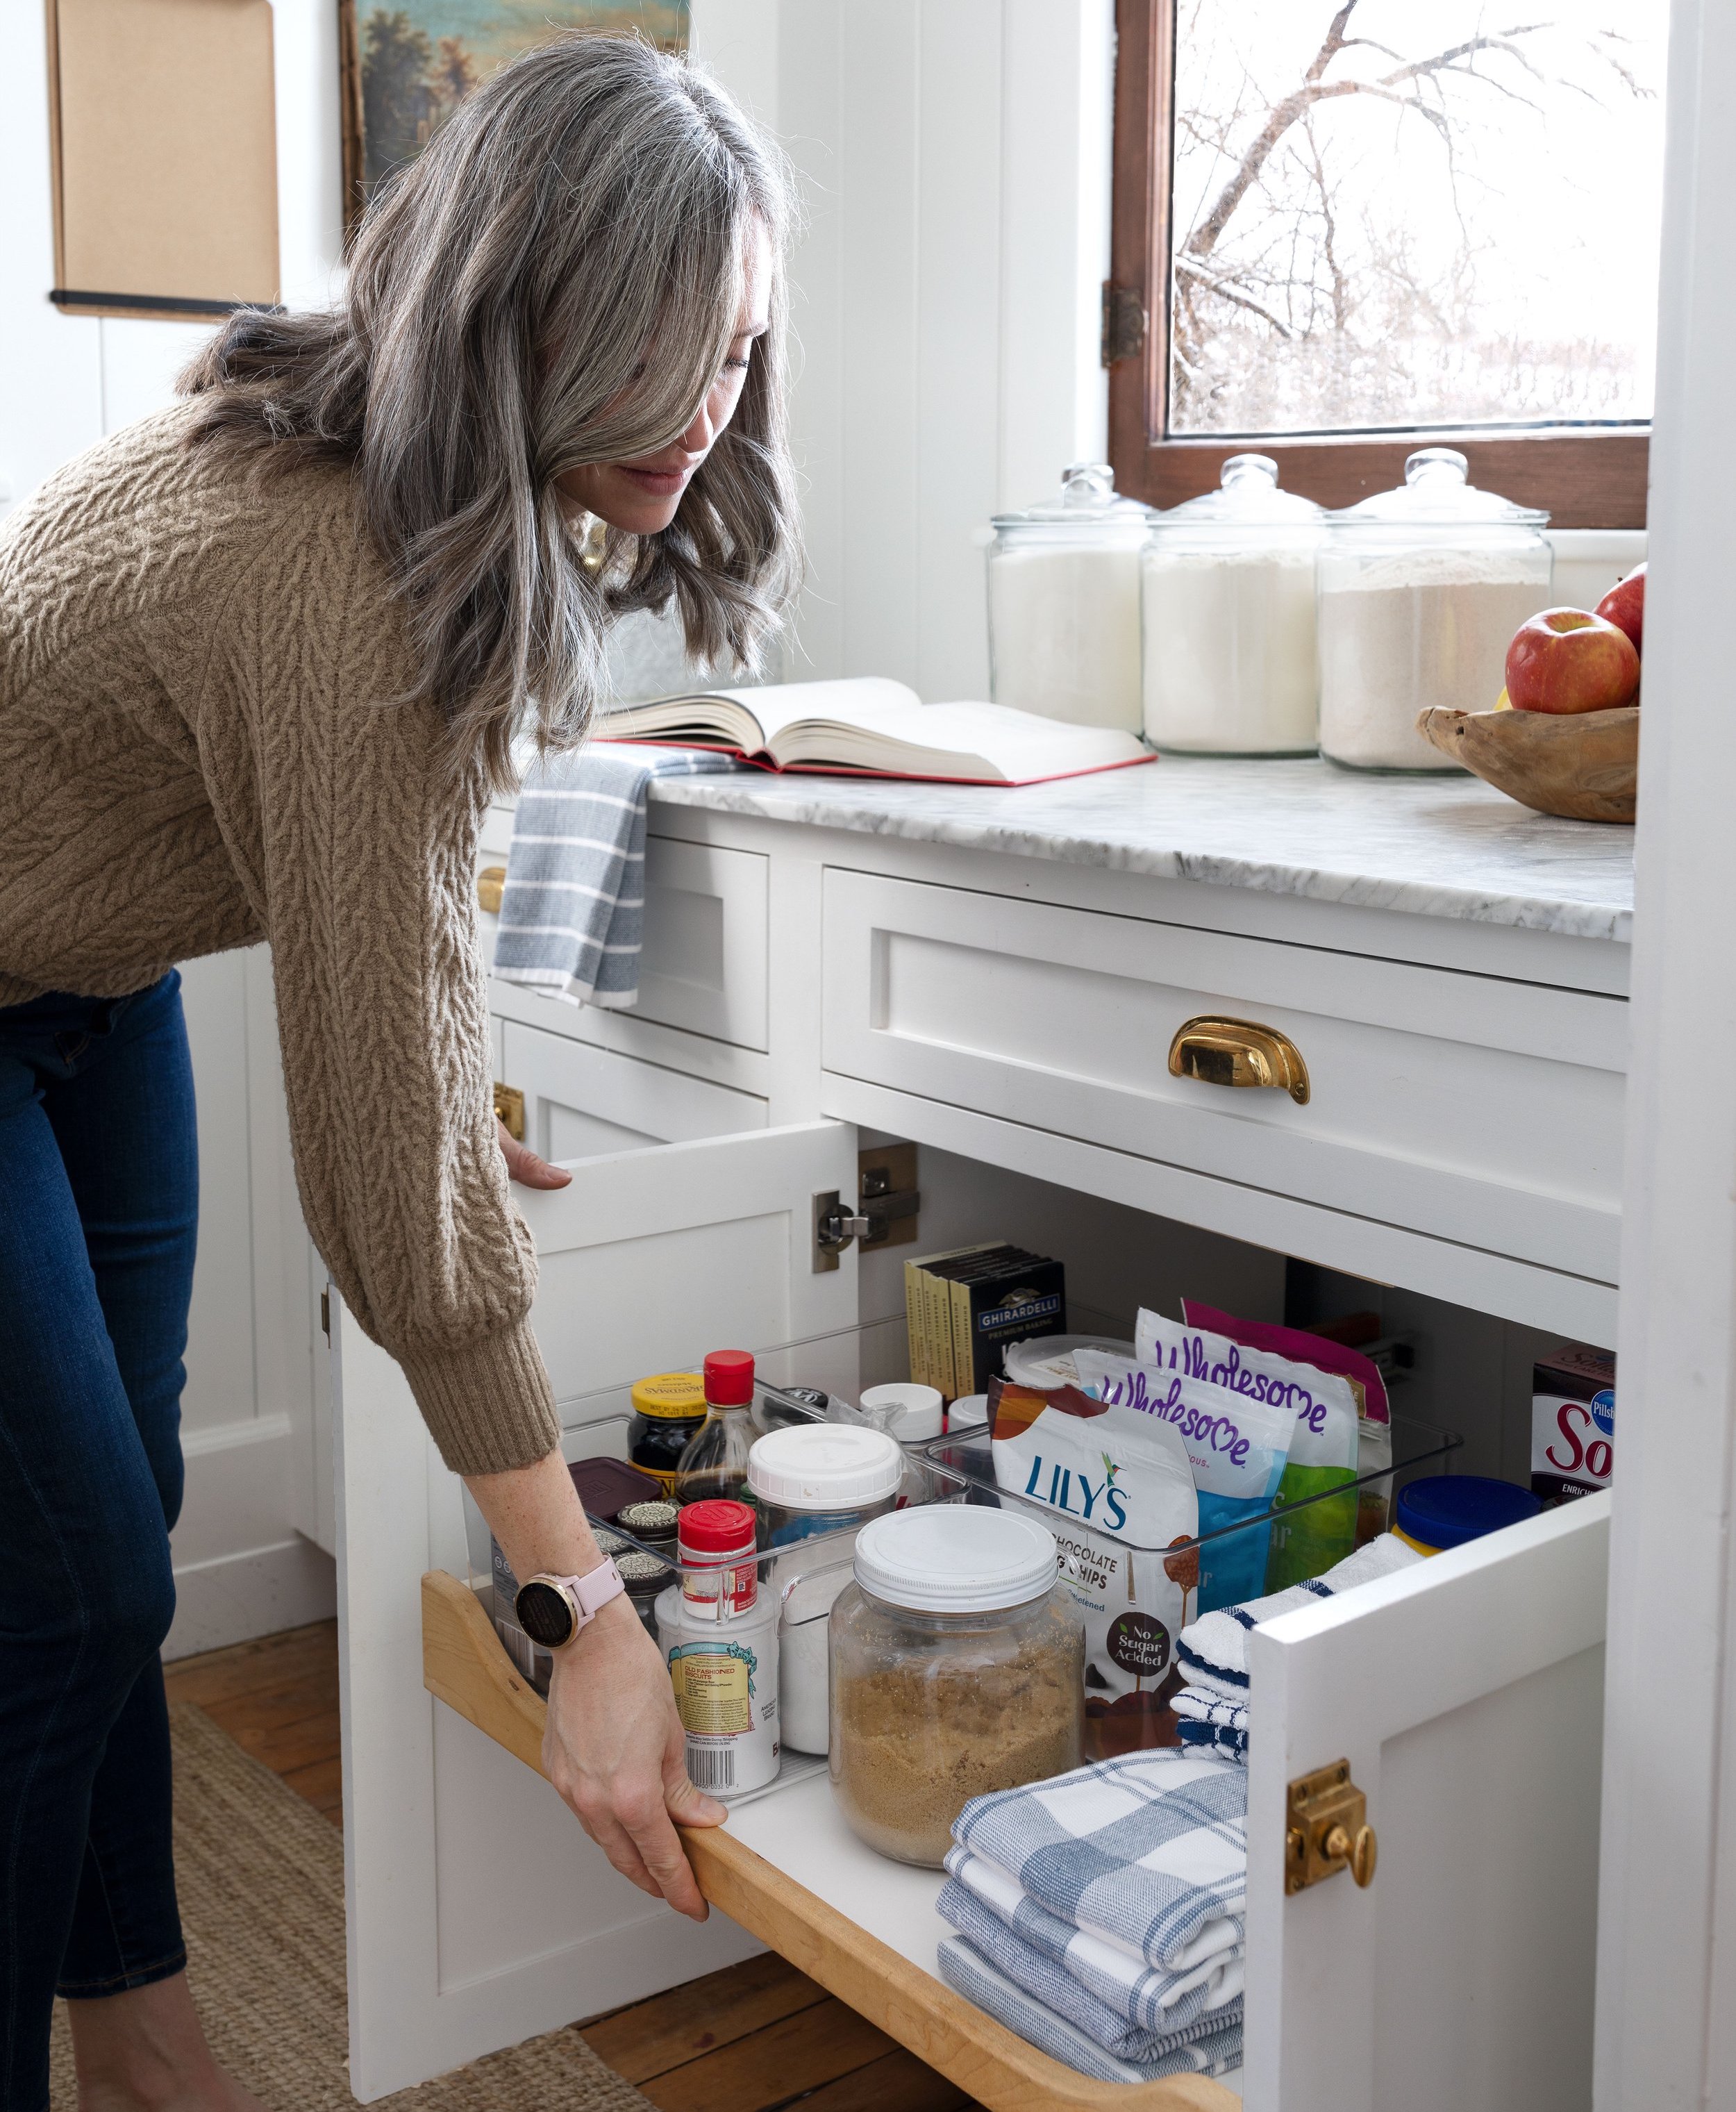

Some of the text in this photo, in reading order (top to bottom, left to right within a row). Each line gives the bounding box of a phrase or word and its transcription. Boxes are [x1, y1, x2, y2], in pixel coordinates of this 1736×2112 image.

[982, 1295, 1057, 1327] GHIRARDELLI
[1155, 1336, 1326, 1433] Wholesome
[1101, 1372, 1250, 1466] Wholesome
[1069, 1564, 1107, 1590] HIPS
[1133, 1625, 1151, 1640] No
[1119, 1635, 1162, 1653] Sugar
[1115, 1649, 1162, 1666] Added
[685, 1670, 712, 1680] BISCUITS
